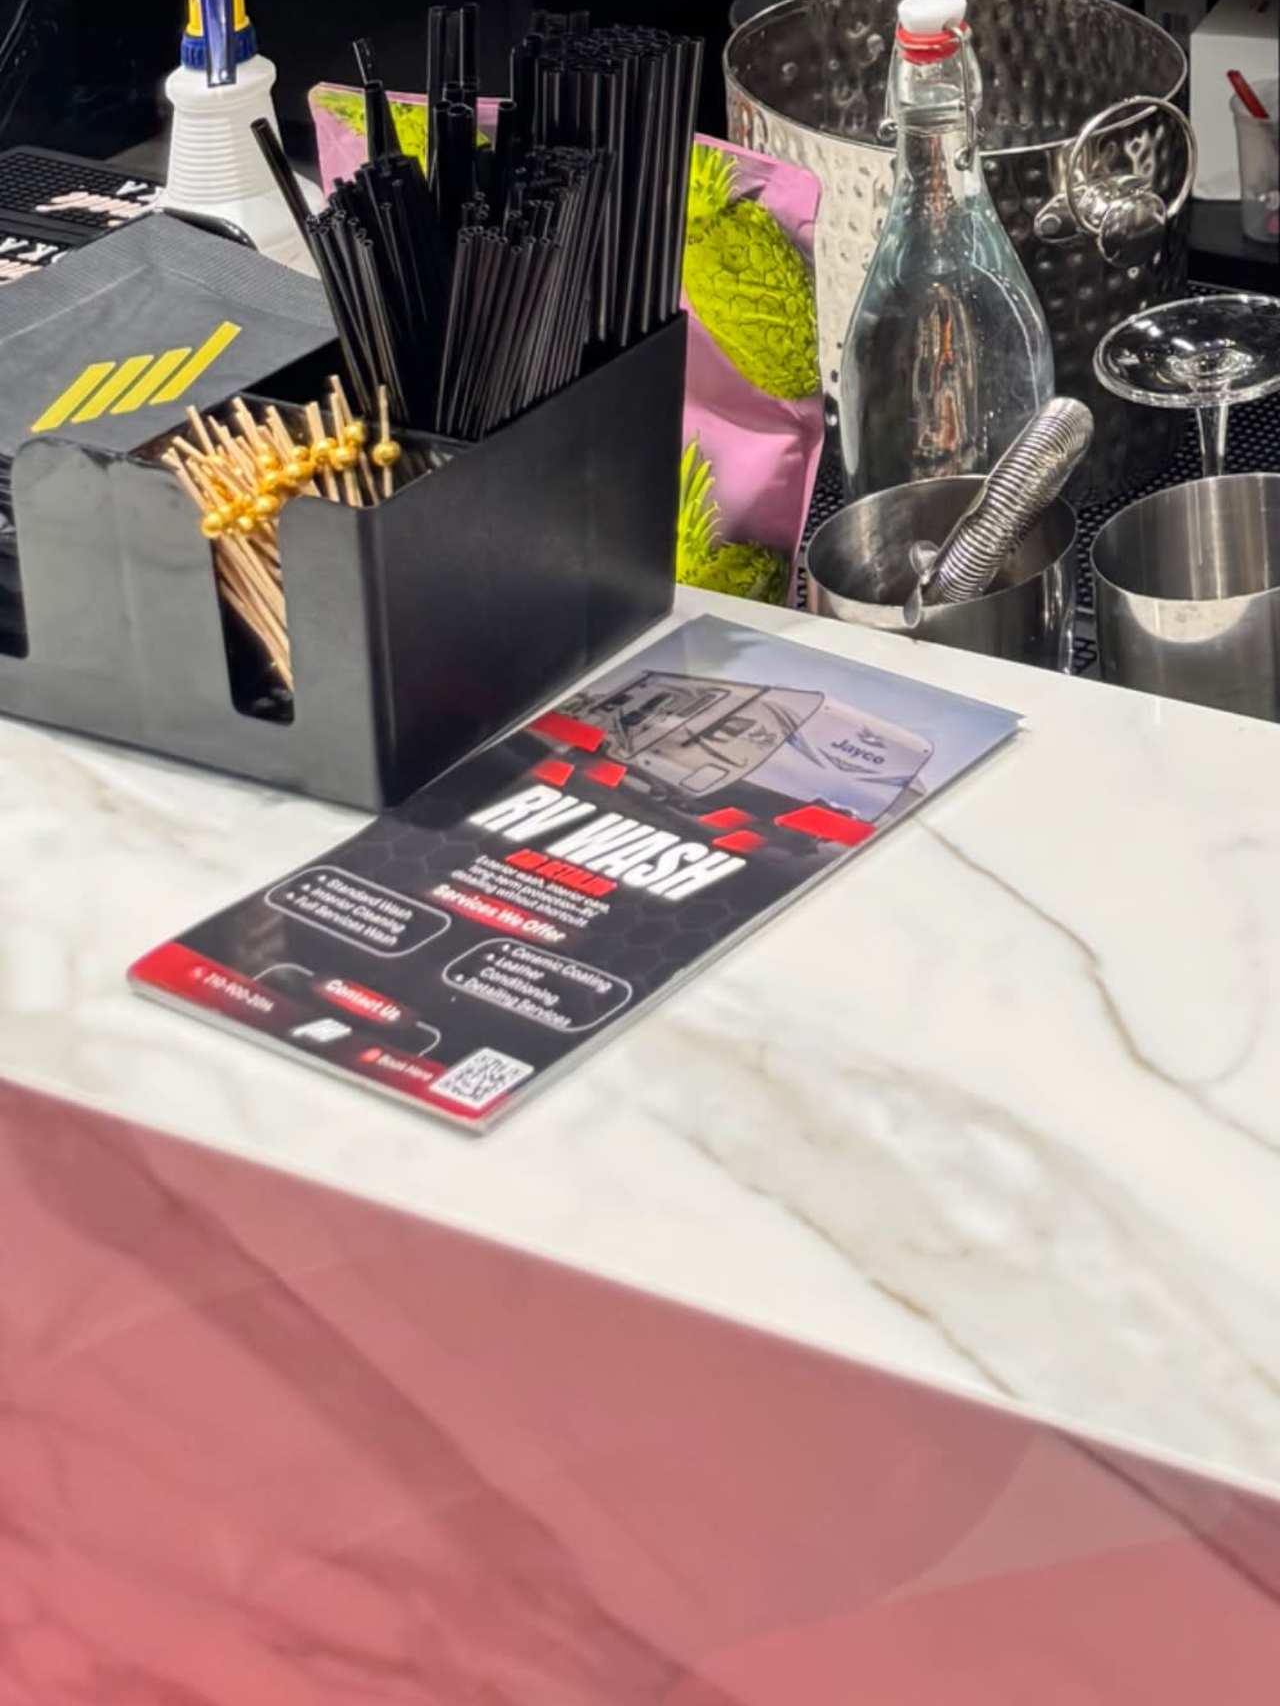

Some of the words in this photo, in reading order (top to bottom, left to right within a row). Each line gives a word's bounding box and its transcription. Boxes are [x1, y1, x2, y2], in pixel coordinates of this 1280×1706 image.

[830, 737, 886, 765] Jayco
[466, 784, 598, 843] RV
[544, 811, 748, 901] WASH
[293, 895, 320, 911] Full
[314, 905, 366, 933] Services
[363, 925, 398, 947] Wash
[310, 887, 355, 910] Interior
[352, 905, 406, 934] Cleaning
[326, 878, 382, 906] Standard
[379, 900, 413, 920] Wash
[432, 883, 499, 917] Services
[496, 909, 524, 928] We
[522, 919, 567, 941] Offer
[480, 967, 560, 1007] Conditioning
[494, 957, 545, 981] Leather
[510, 947, 564, 971] Ceramic
[561, 964, 613, 994] Coating
[324, 978, 382, 1014] Contact
[380, 1002, 402, 1022] Us
[463, 977, 520, 1009] Detailing
[517, 998, 573, 1028] Services
